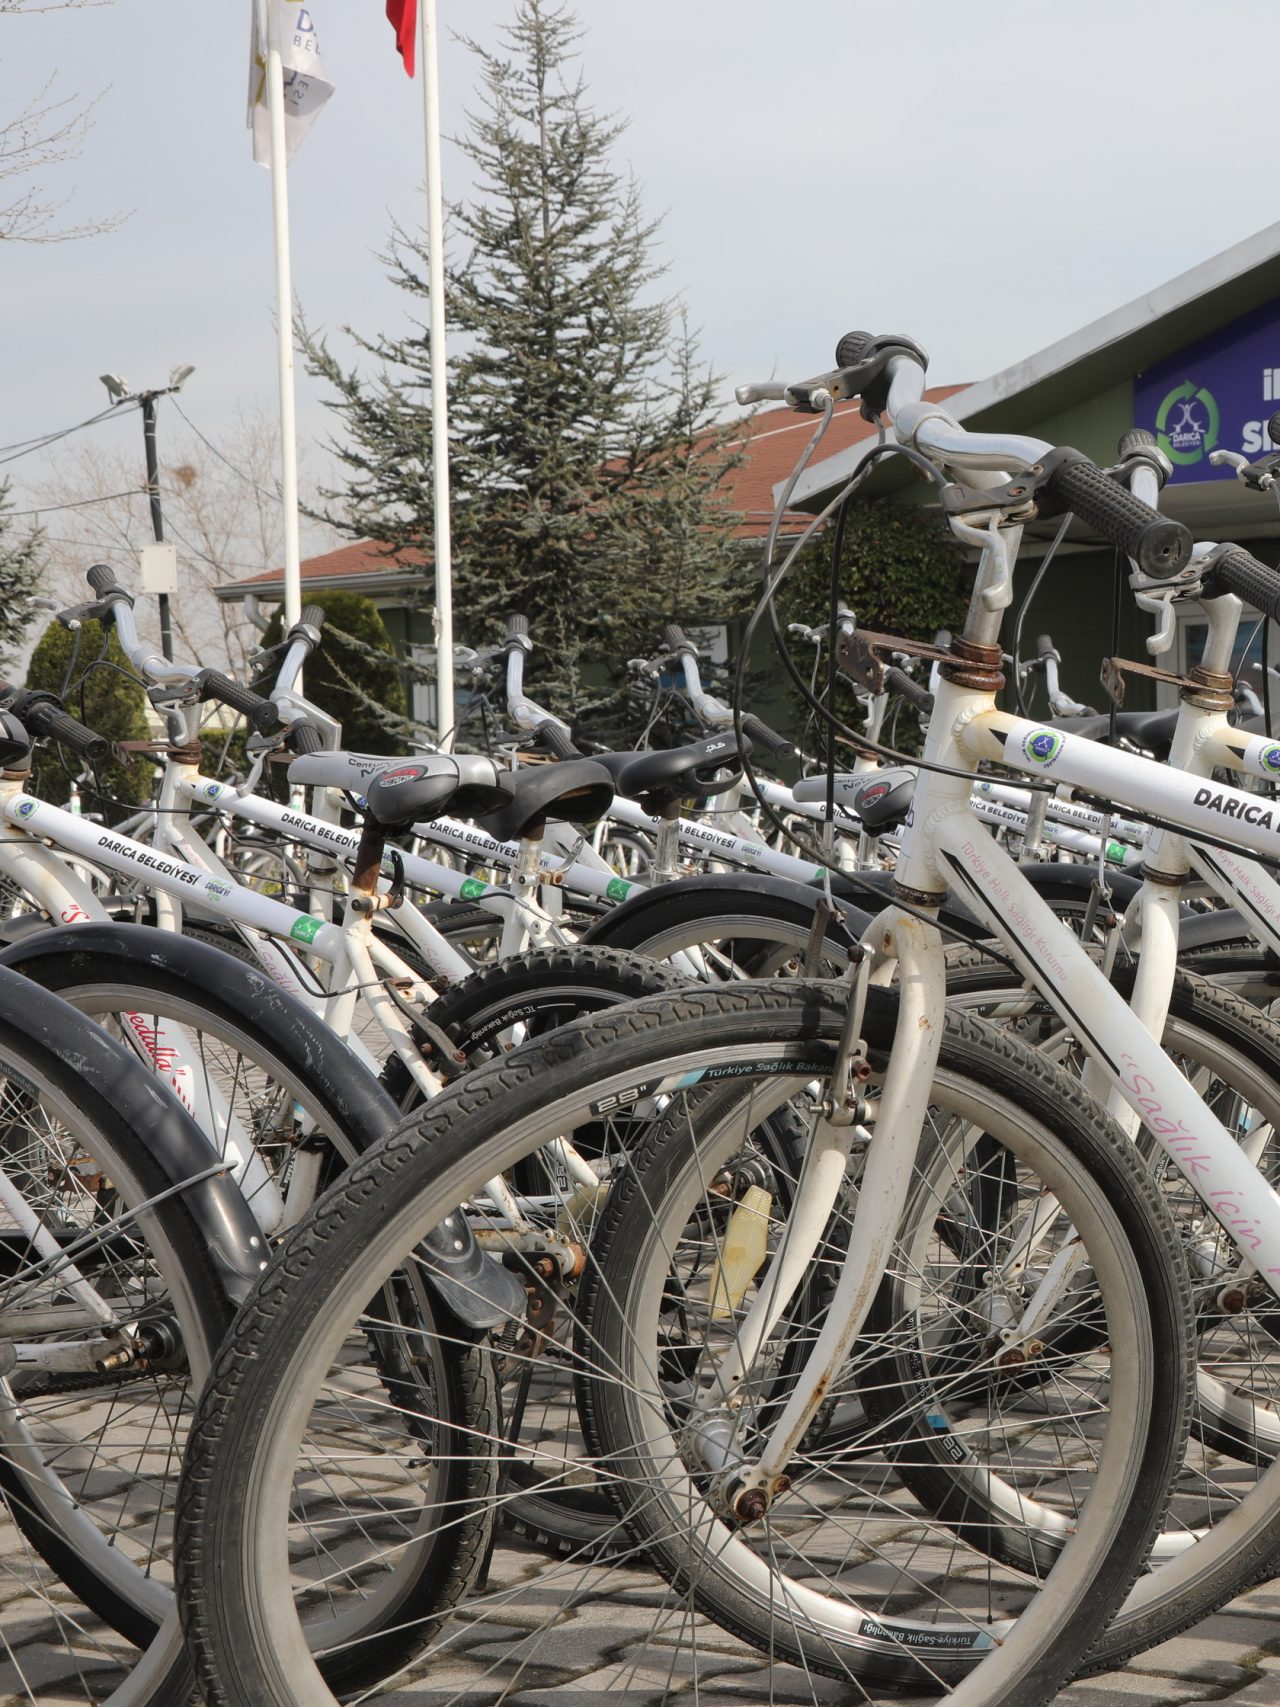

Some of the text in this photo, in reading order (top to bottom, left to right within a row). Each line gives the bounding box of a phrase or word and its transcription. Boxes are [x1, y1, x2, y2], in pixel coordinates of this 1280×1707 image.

[1194, 788, 1272, 830] DARICA
[281, 813, 316, 834] DARICA
[429, 820, 464, 839] DARICA
[98, 836, 202, 885] DARICA BELEDİYESİ
[1232, 864, 1251, 887] Halk
[961, 840, 991, 879] Türkiye
[989, 878, 1010, 902] Halk
[1035, 937, 1068, 982] Kurumu
[708, 1064, 753, 1079] Türkiye
[756, 1061, 792, 1074] Sağlık
[596, 1084, 648, 1113] 28"
